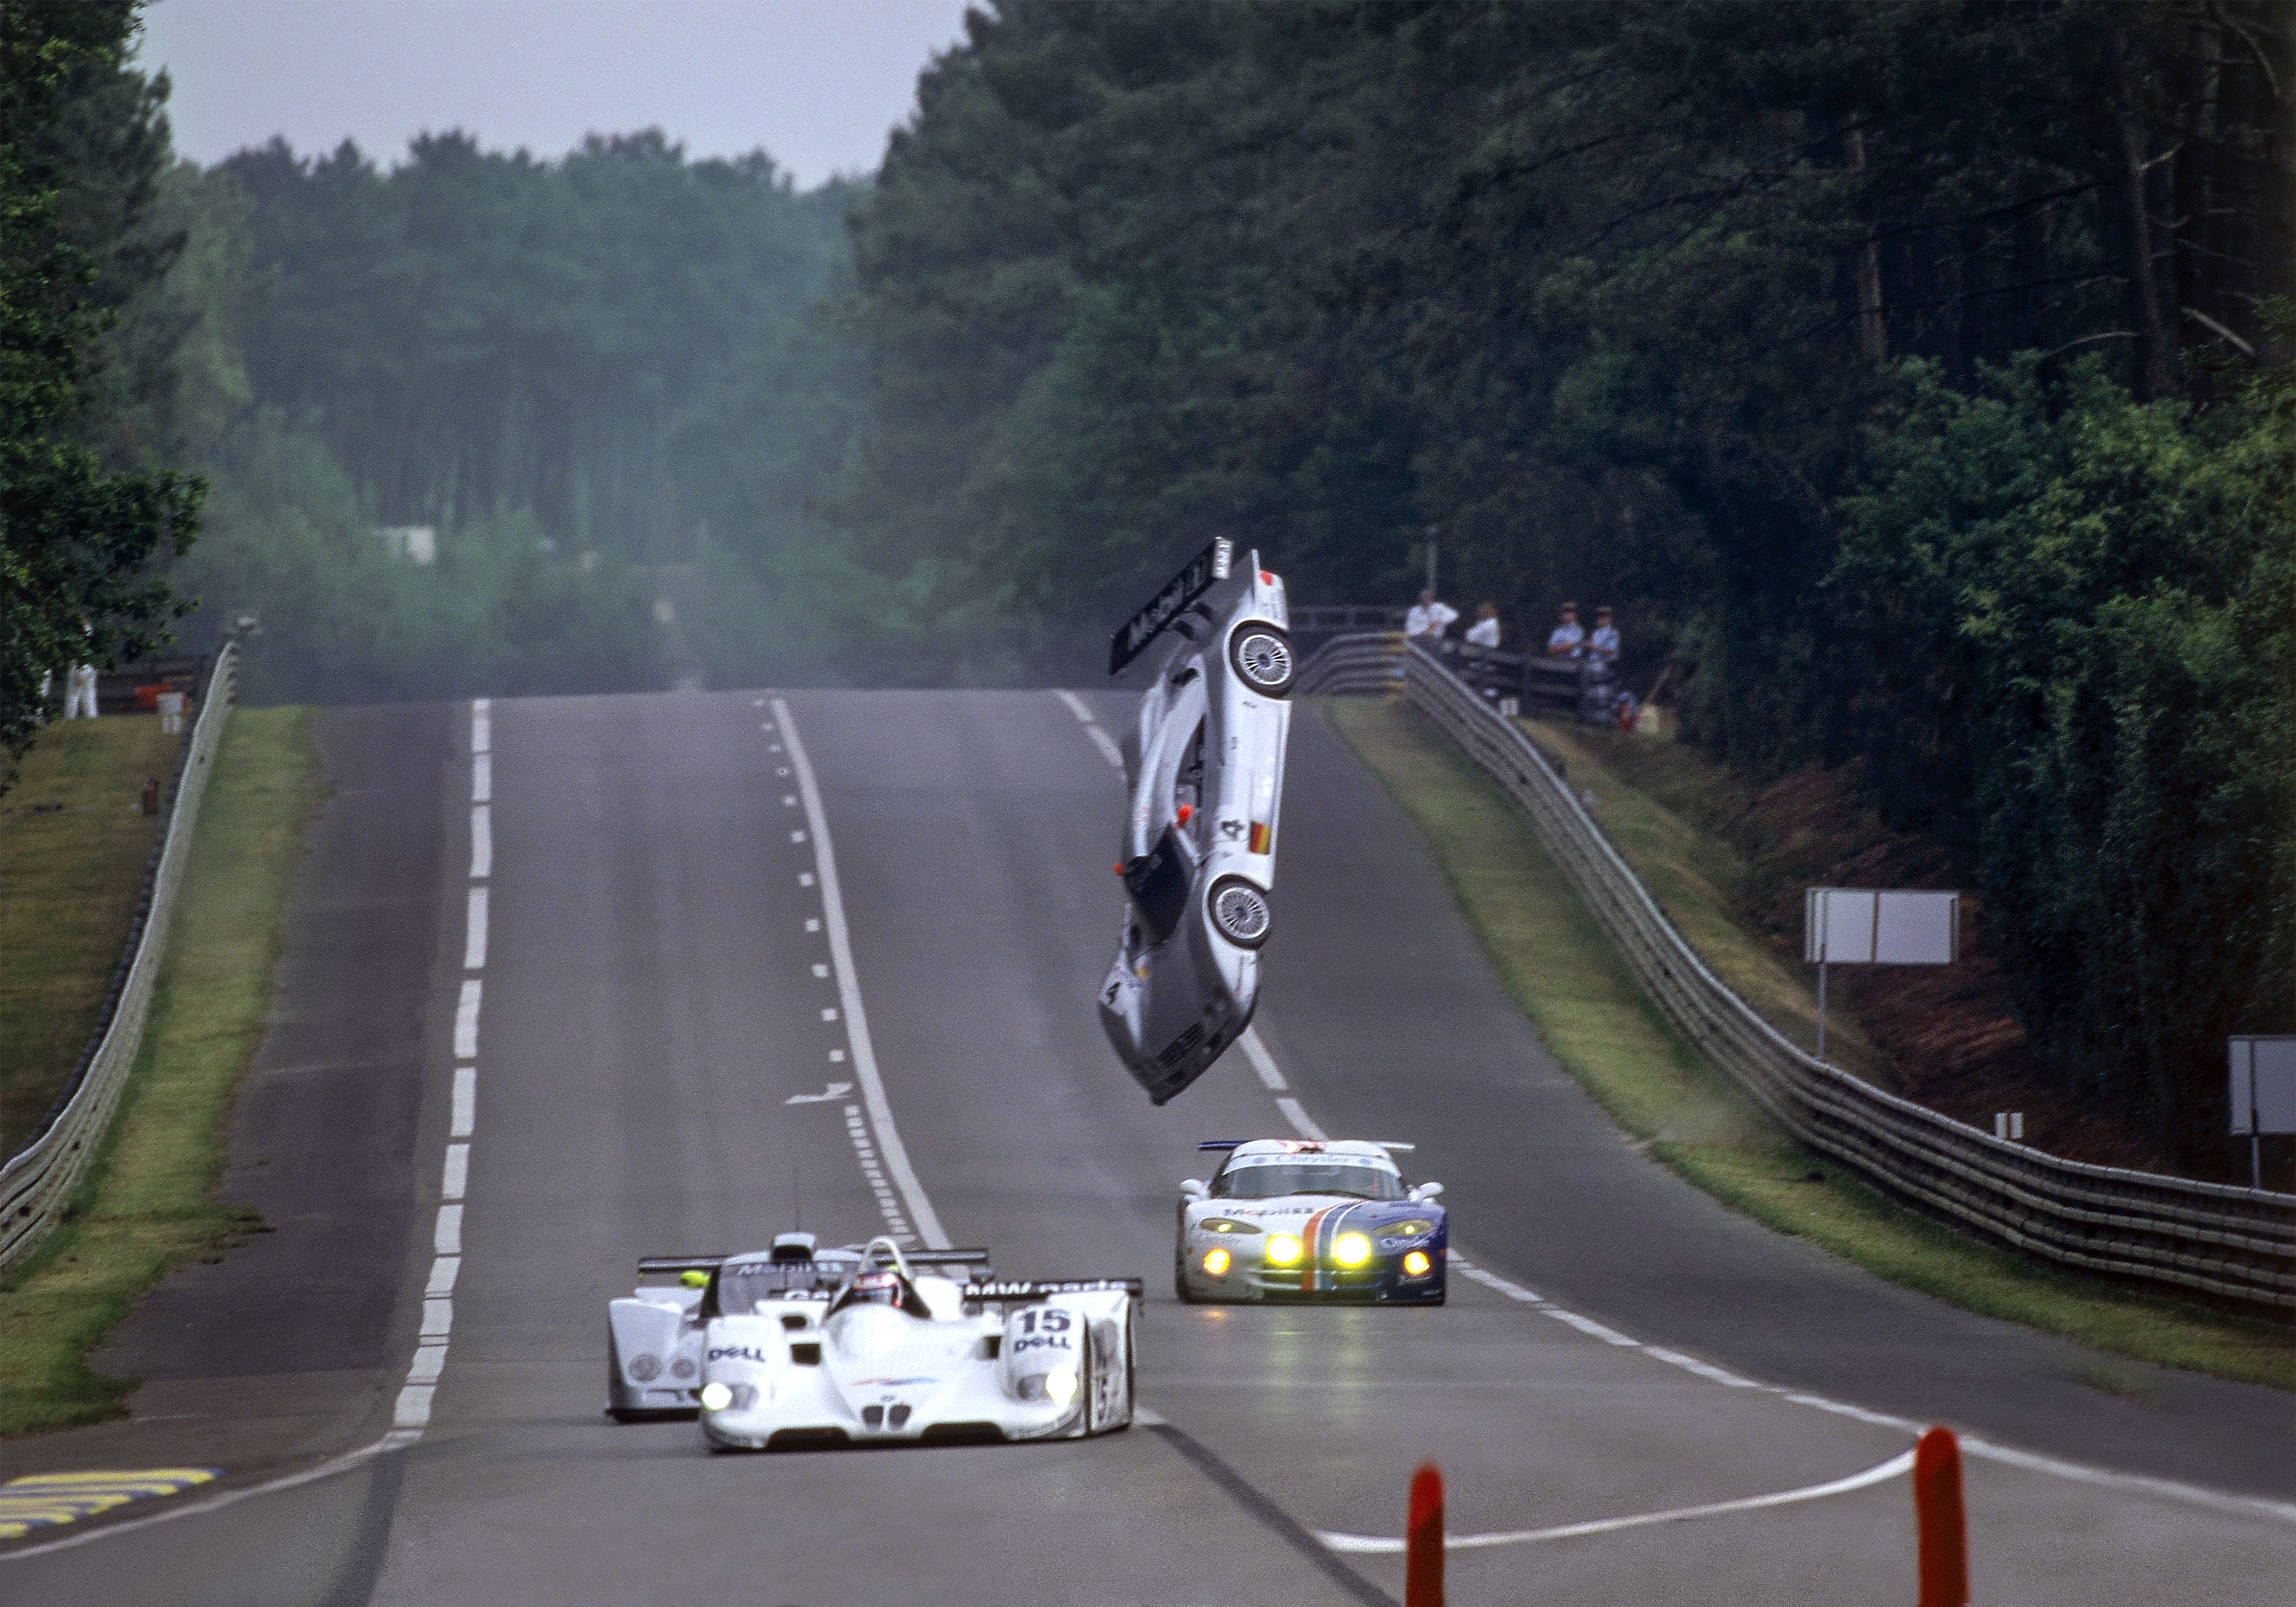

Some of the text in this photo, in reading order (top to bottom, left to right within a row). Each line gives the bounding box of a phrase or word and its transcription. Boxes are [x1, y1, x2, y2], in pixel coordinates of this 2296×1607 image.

[1018, 1309, 1070, 1333] 15
[1014, 1336, 1071, 1353] DELL
[709, 1345, 765, 1363] DELL
